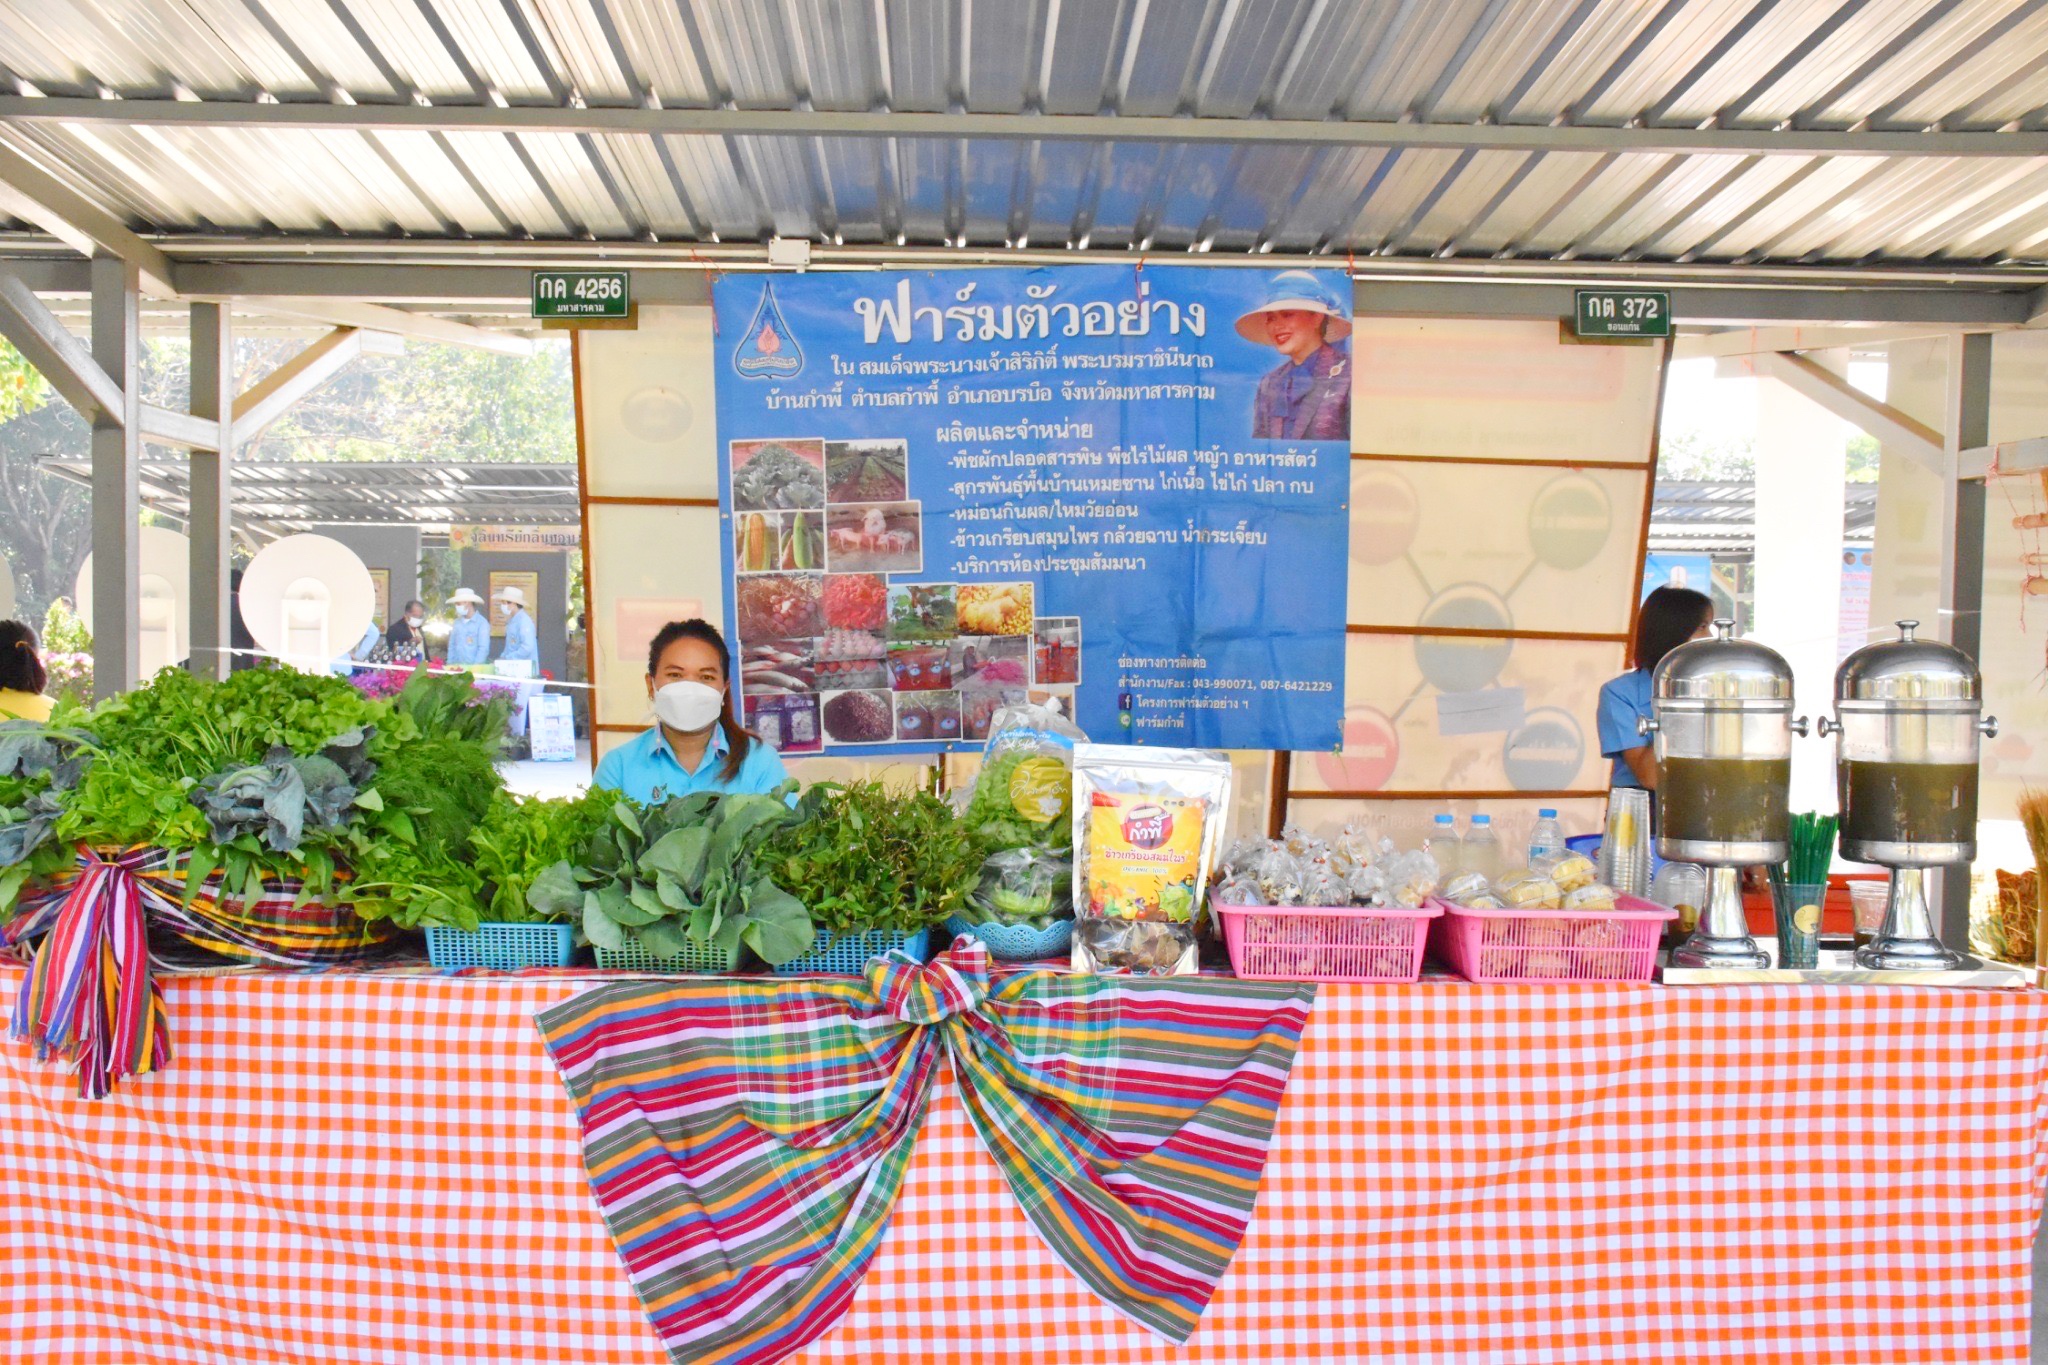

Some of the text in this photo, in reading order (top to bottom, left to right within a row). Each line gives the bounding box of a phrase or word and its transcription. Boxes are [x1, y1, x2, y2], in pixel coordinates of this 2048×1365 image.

[540, 278, 622, 299] กค 4256
[557, 303, 605, 312] มหาสารคาม
[853, 278, 1206, 344] ฟาร์มตัวอย่าง
[1622, 298, 1658, 319] 372
[1607, 321, 1640, 331] ขอนแก่น
[831, 344, 1214, 376] ใน สมเด็จพระนางเจ้าสิริกิติ์ พระบรมราชินีนาถ
[766, 378, 1215, 409] บ้านกำพี้ ตำบลกำพี้ อำเภอบรบือ จังหวัดมหาสารคาม
[936, 416, 1093, 443] ผลิตและจำหน่าย
[1107, 444, 1188, 465] พืชไร่ไม้ผล
[1193, 444, 1228, 469] หญ้า
[1234, 448, 1317, 468] อาหารสัตว์
[1160, 465, 1204, 490] ไก่เนื้อ
[1210, 470, 1247, 491] ไข่ไก่
[1252, 476, 1284, 493] ปลา
[1290, 479, 1314, 494] กบ
[1104, 524, 1177, 544] กล้วยฉาบ
[1118, 653, 1206, 668] ช่องทางการติดต่อ
[1260, 680, 1333, 692] 087-6421229
